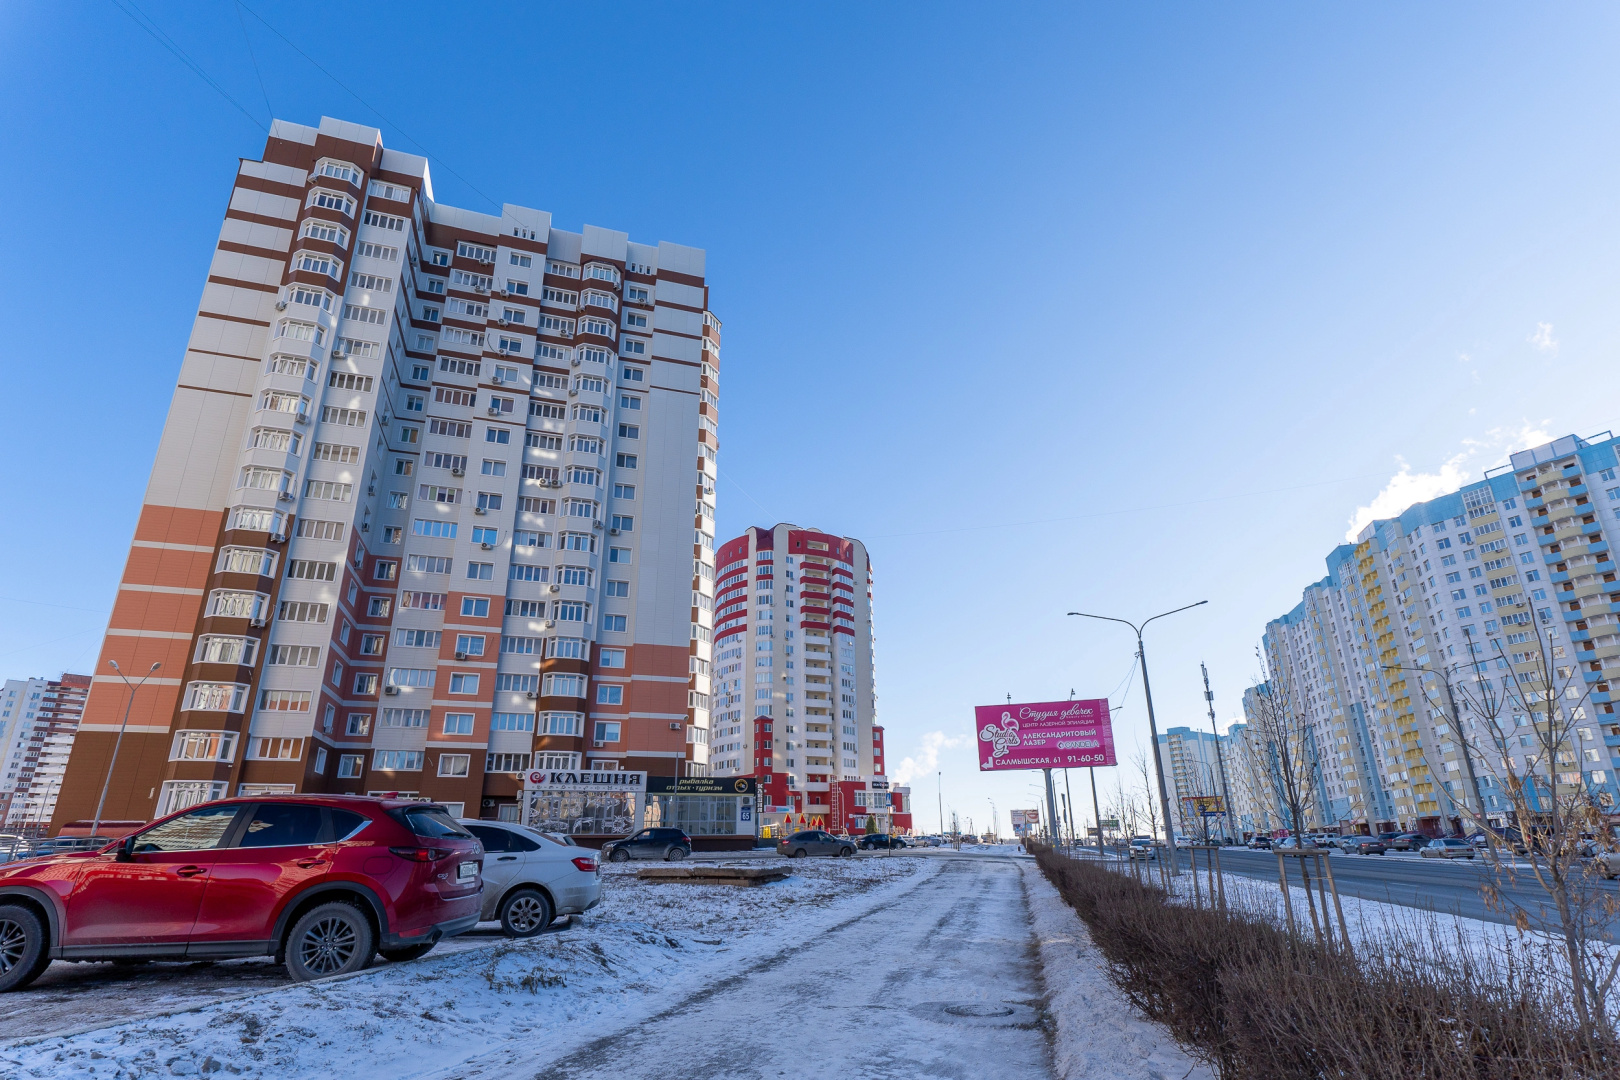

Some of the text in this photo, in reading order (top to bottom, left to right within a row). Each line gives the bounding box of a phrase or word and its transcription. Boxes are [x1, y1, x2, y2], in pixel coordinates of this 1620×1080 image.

[1020, 704, 1093, 721] Студия девочек
[1022, 728, 1097, 740] АЛЕКСАНДРИТОВЫЙ
[1064, 740, 1100, 748] CANDELA
[1067, 754, 1104, 762] 91-60-50
[550, 772, 641, 785] КЛЕШНЯ
[742, 812, 750, 820] 65
